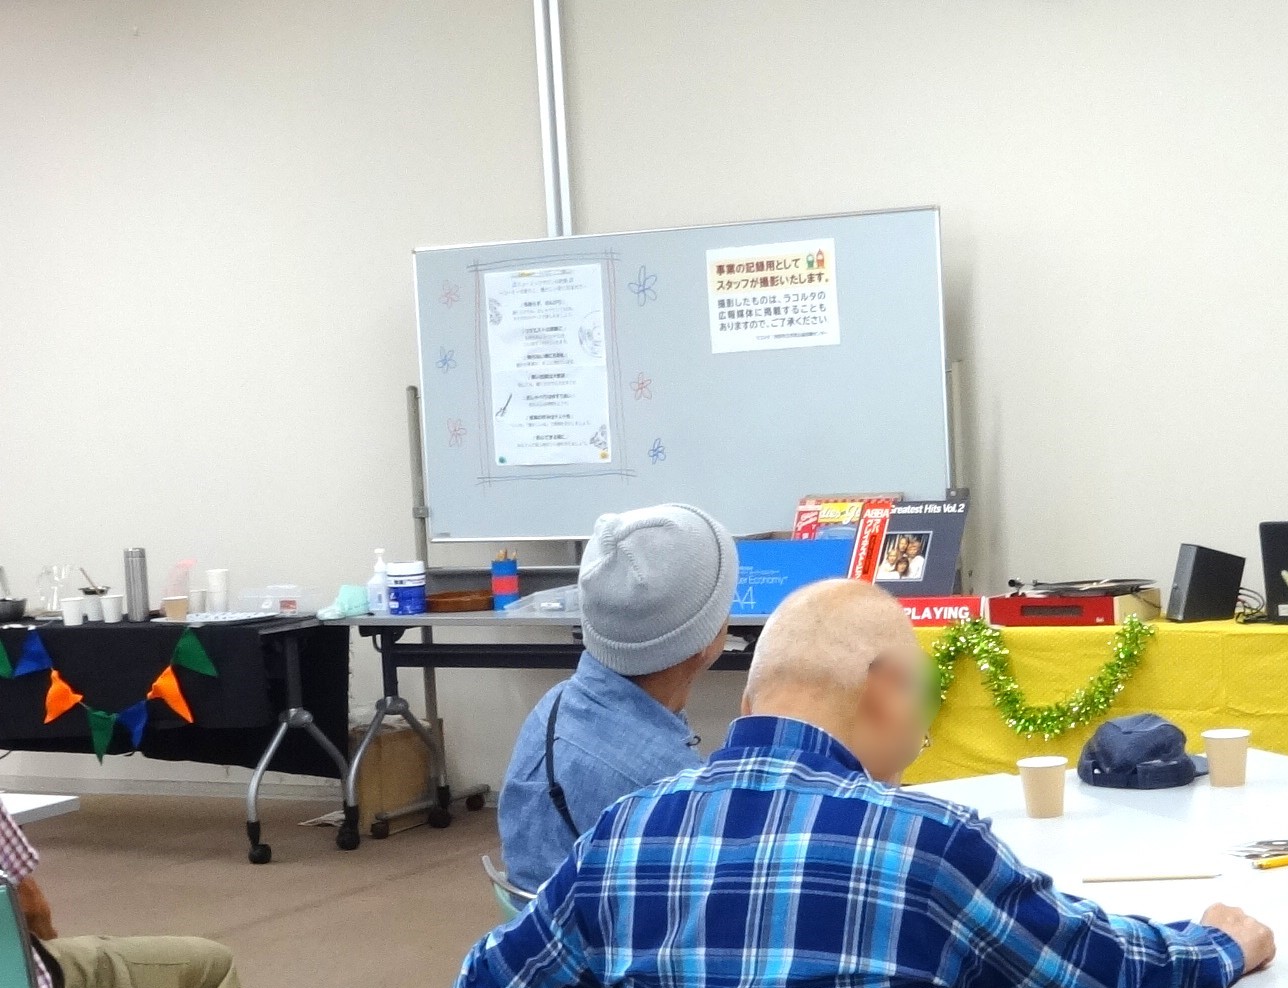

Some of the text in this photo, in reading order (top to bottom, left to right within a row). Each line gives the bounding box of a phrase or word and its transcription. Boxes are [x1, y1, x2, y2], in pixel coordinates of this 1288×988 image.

[716, 258, 801, 276] 事業の記録用として
[716, 272, 829, 291] スタッフが撮影いたします。
[717, 291, 826, 309] 撮影したものは、ラコルタの
[718, 303, 827, 320] 広報媒体に掲載することも
[863, 509, 889, 518] ABBA
[924, 504, 942, 514] Hits
[903, 606, 970, 620] PLAYING
